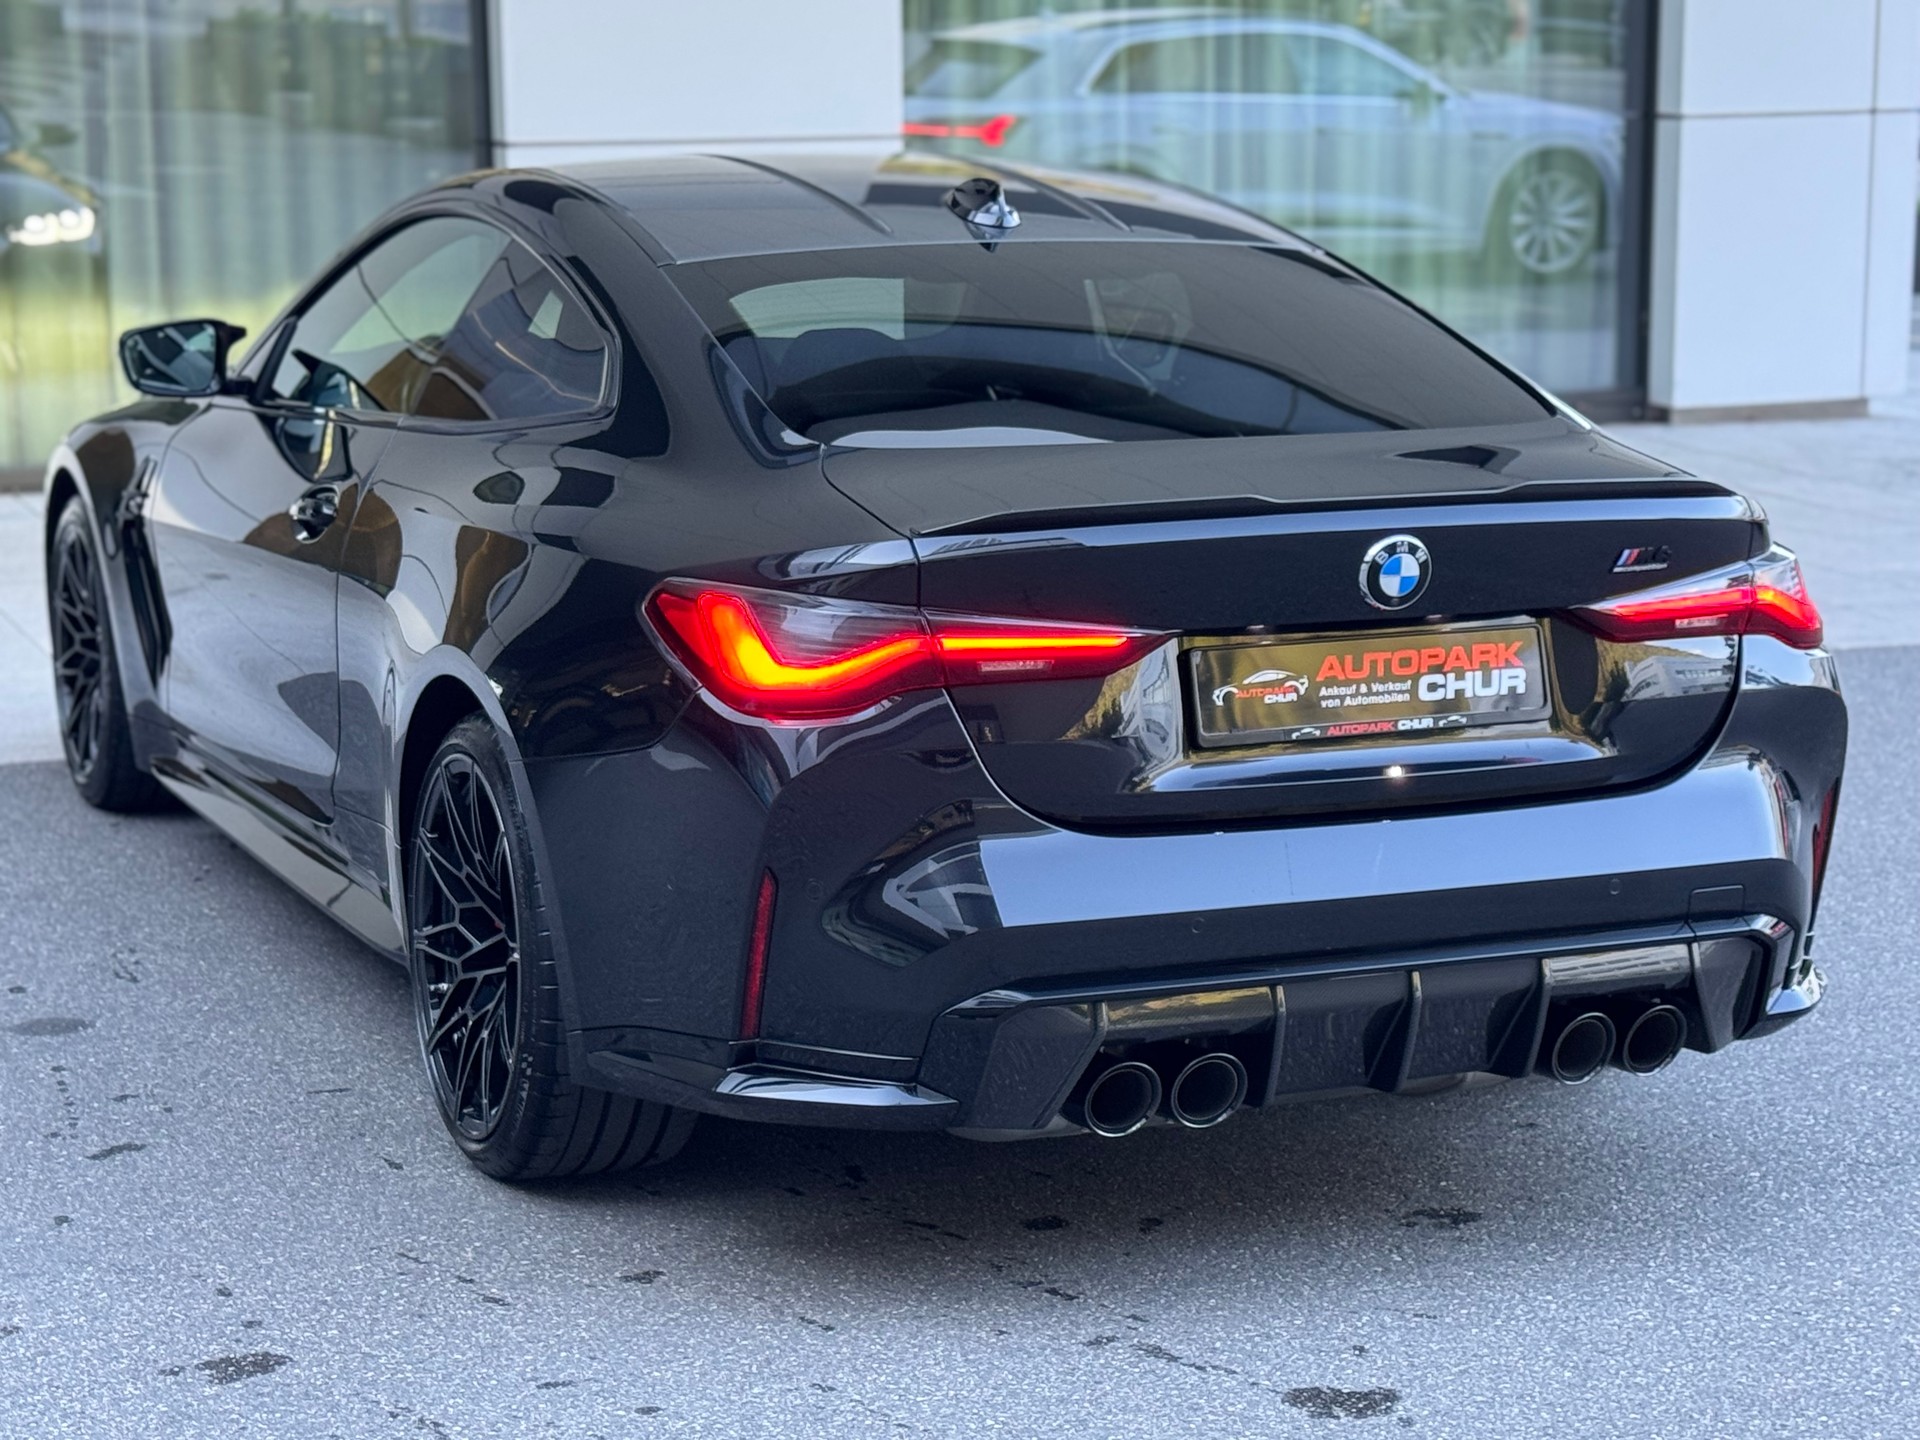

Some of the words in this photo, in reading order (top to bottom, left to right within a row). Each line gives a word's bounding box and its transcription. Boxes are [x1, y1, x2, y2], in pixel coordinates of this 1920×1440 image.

[1374, 540, 1428, 564] BMW
[1316, 640, 1524, 682] AUTOPARK
[1236, 686, 1296, 699] AUTOPARK
[1319, 684, 1357, 697] Ankauf
[1359, 683, 1368, 694] &
[1371, 679, 1412, 693] Verkauf
[1418, 667, 1527, 702] CHUR
[1264, 692, 1298, 705] CHUR
[1320, 698, 1341, 709] von
[1343, 693, 1411, 707] Automobilen
[1327, 721, 1396, 737] AUTOPARK
[1397, 717, 1434, 731] CHUR
